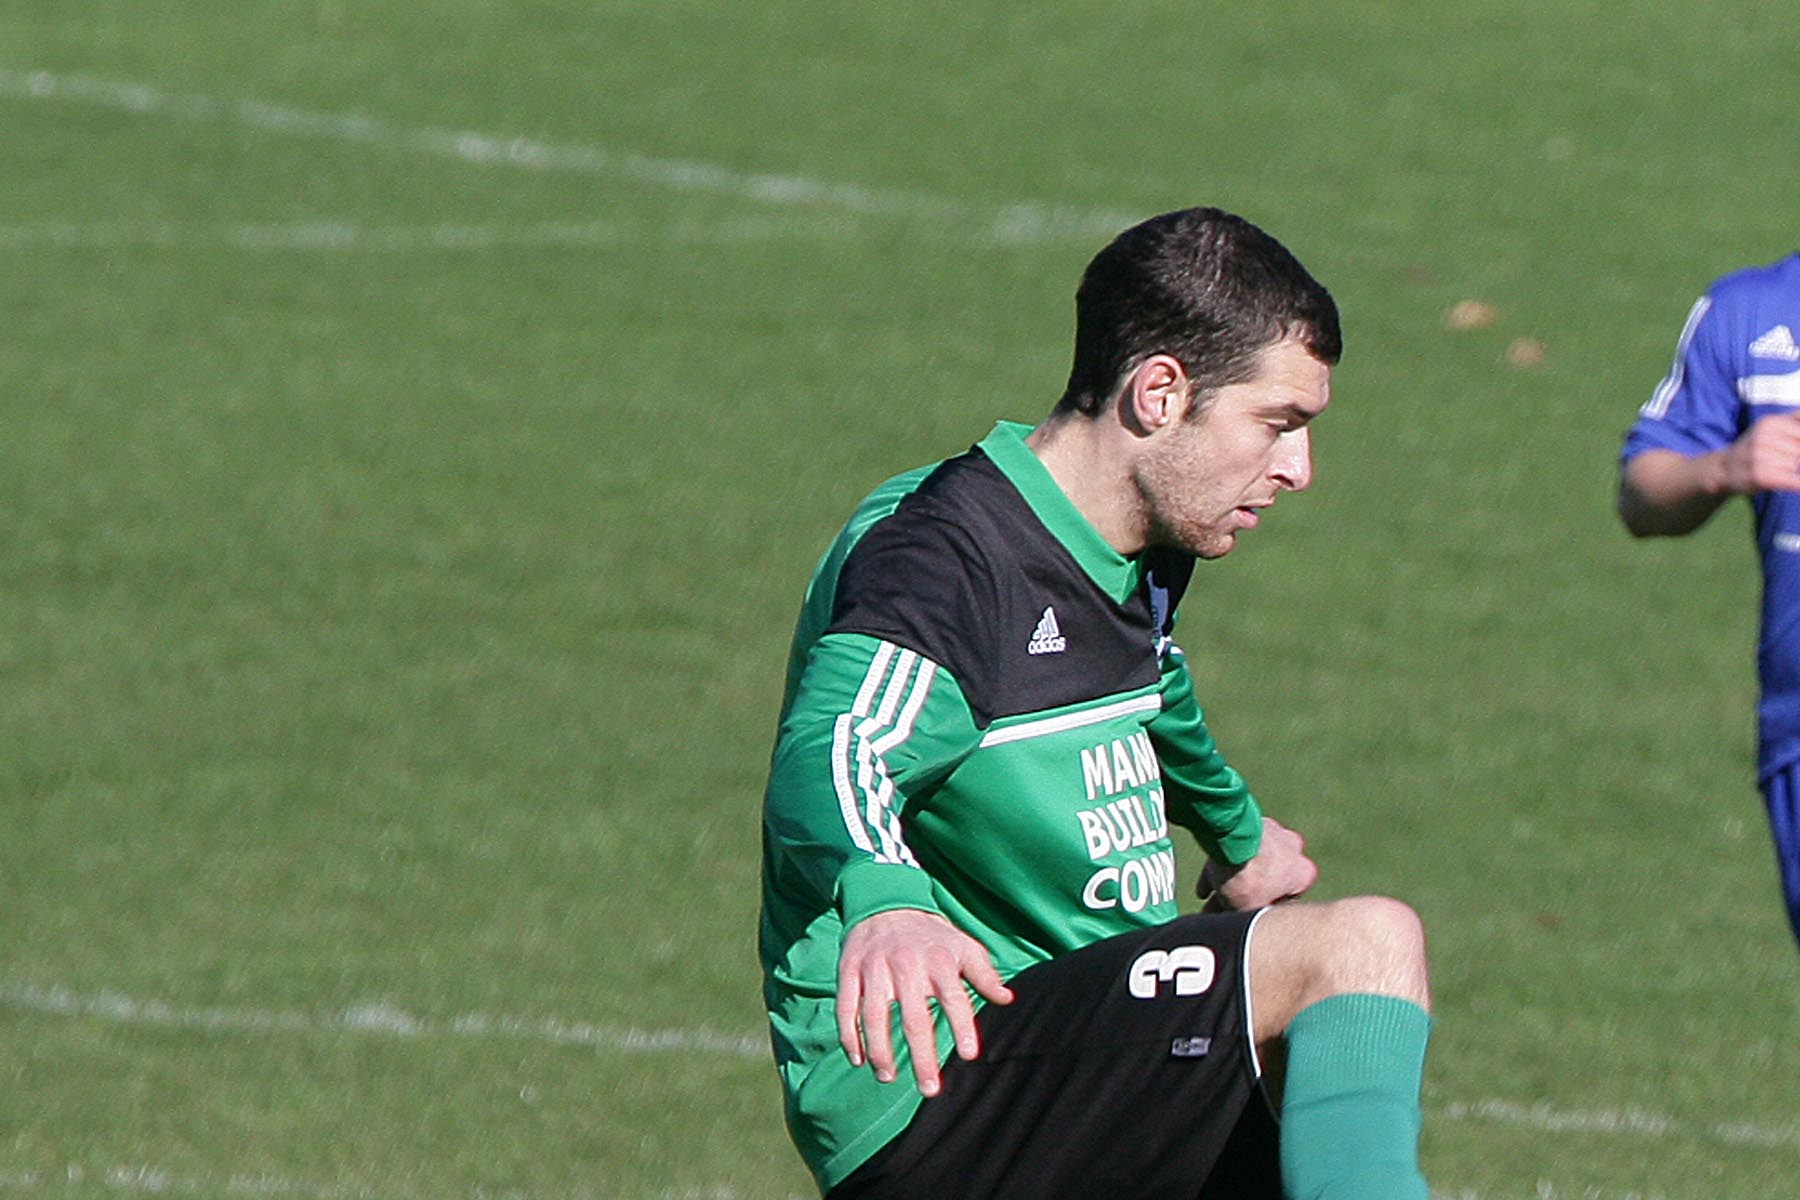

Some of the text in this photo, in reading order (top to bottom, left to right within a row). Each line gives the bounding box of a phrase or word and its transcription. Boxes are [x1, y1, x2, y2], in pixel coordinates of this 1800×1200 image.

[1076, 786, 1168, 861] BUILD
[1083, 846, 1176, 913] COMP
[1128, 945, 1216, 999] 3
